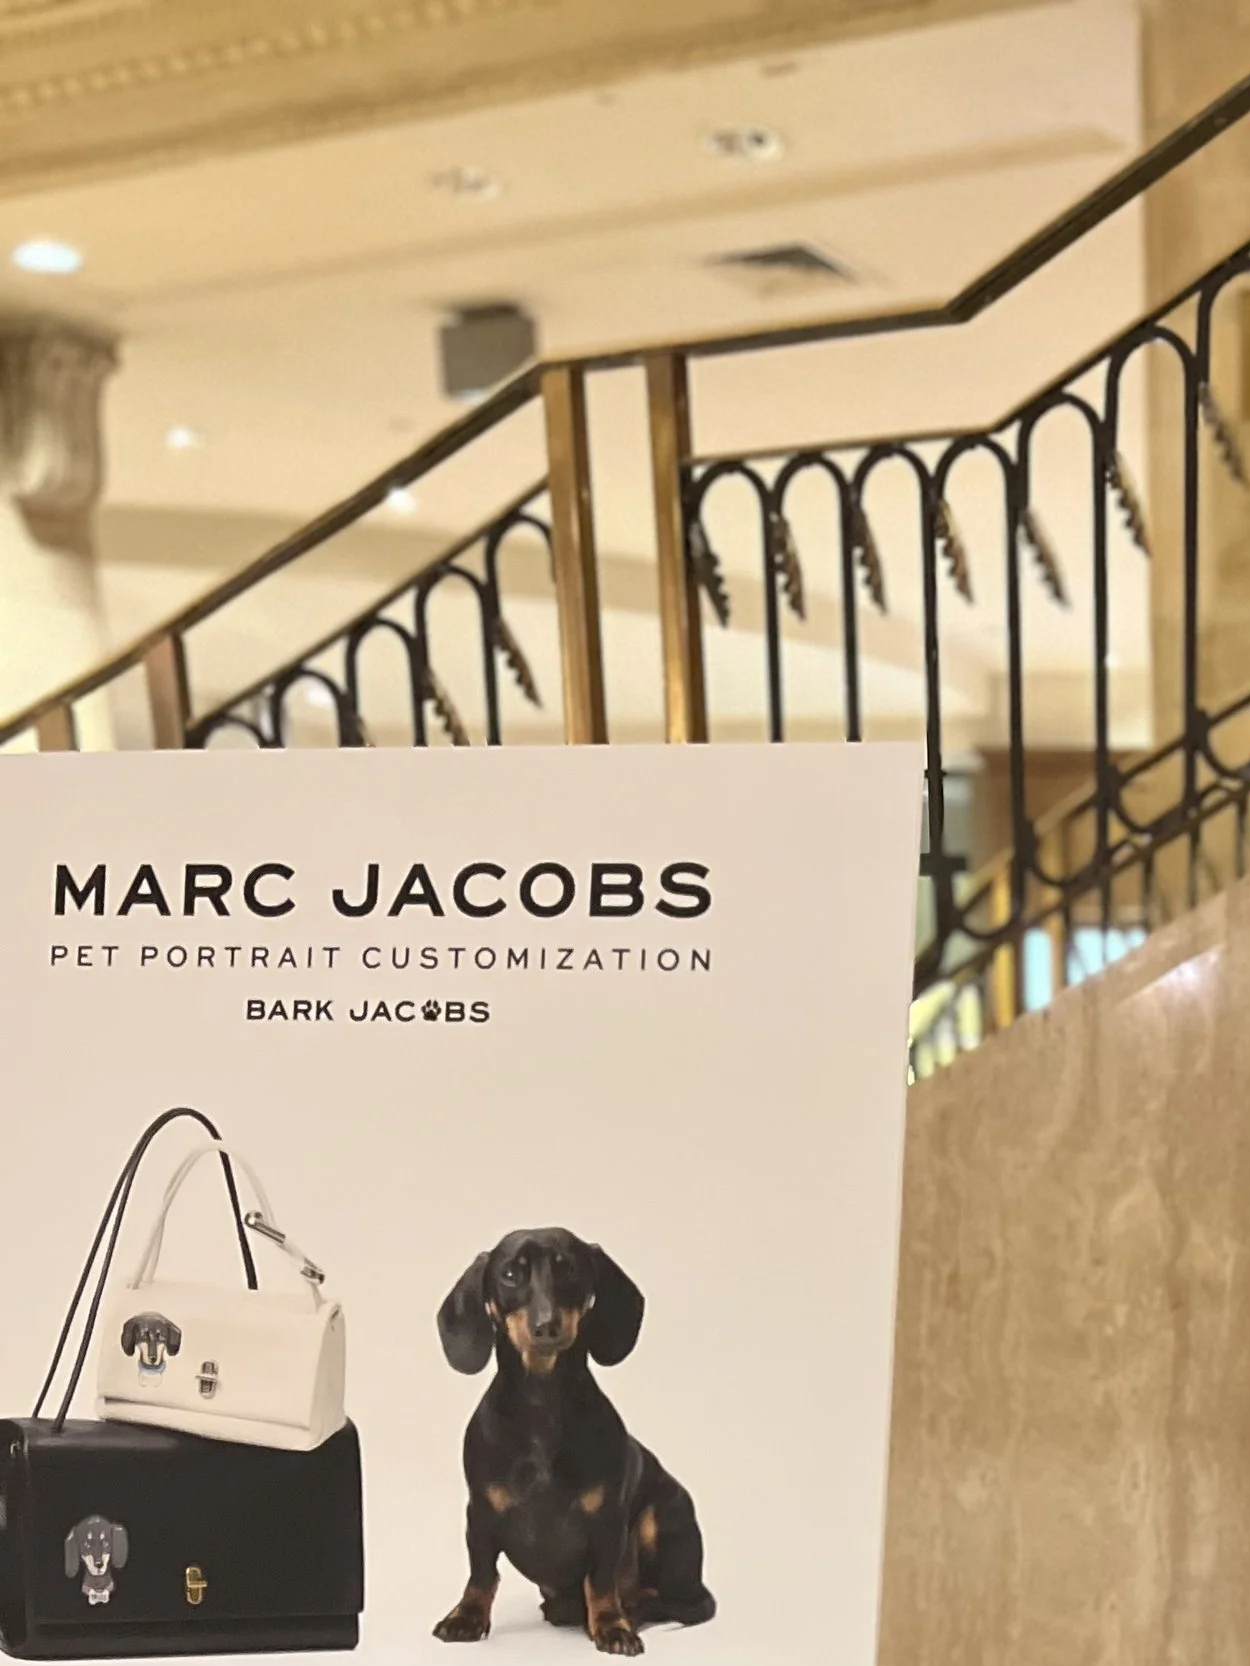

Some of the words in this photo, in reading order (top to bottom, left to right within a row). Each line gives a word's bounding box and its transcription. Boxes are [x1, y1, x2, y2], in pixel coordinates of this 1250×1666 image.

[53, 862, 297, 918] MARC
[331, 861, 713, 920] JACOBS
[50, 944, 121, 968] PET
[139, 944, 342, 970] PORTRAIT
[361, 945, 712, 973] CUSTOMIZATION
[245, 997, 337, 1023] BARK
